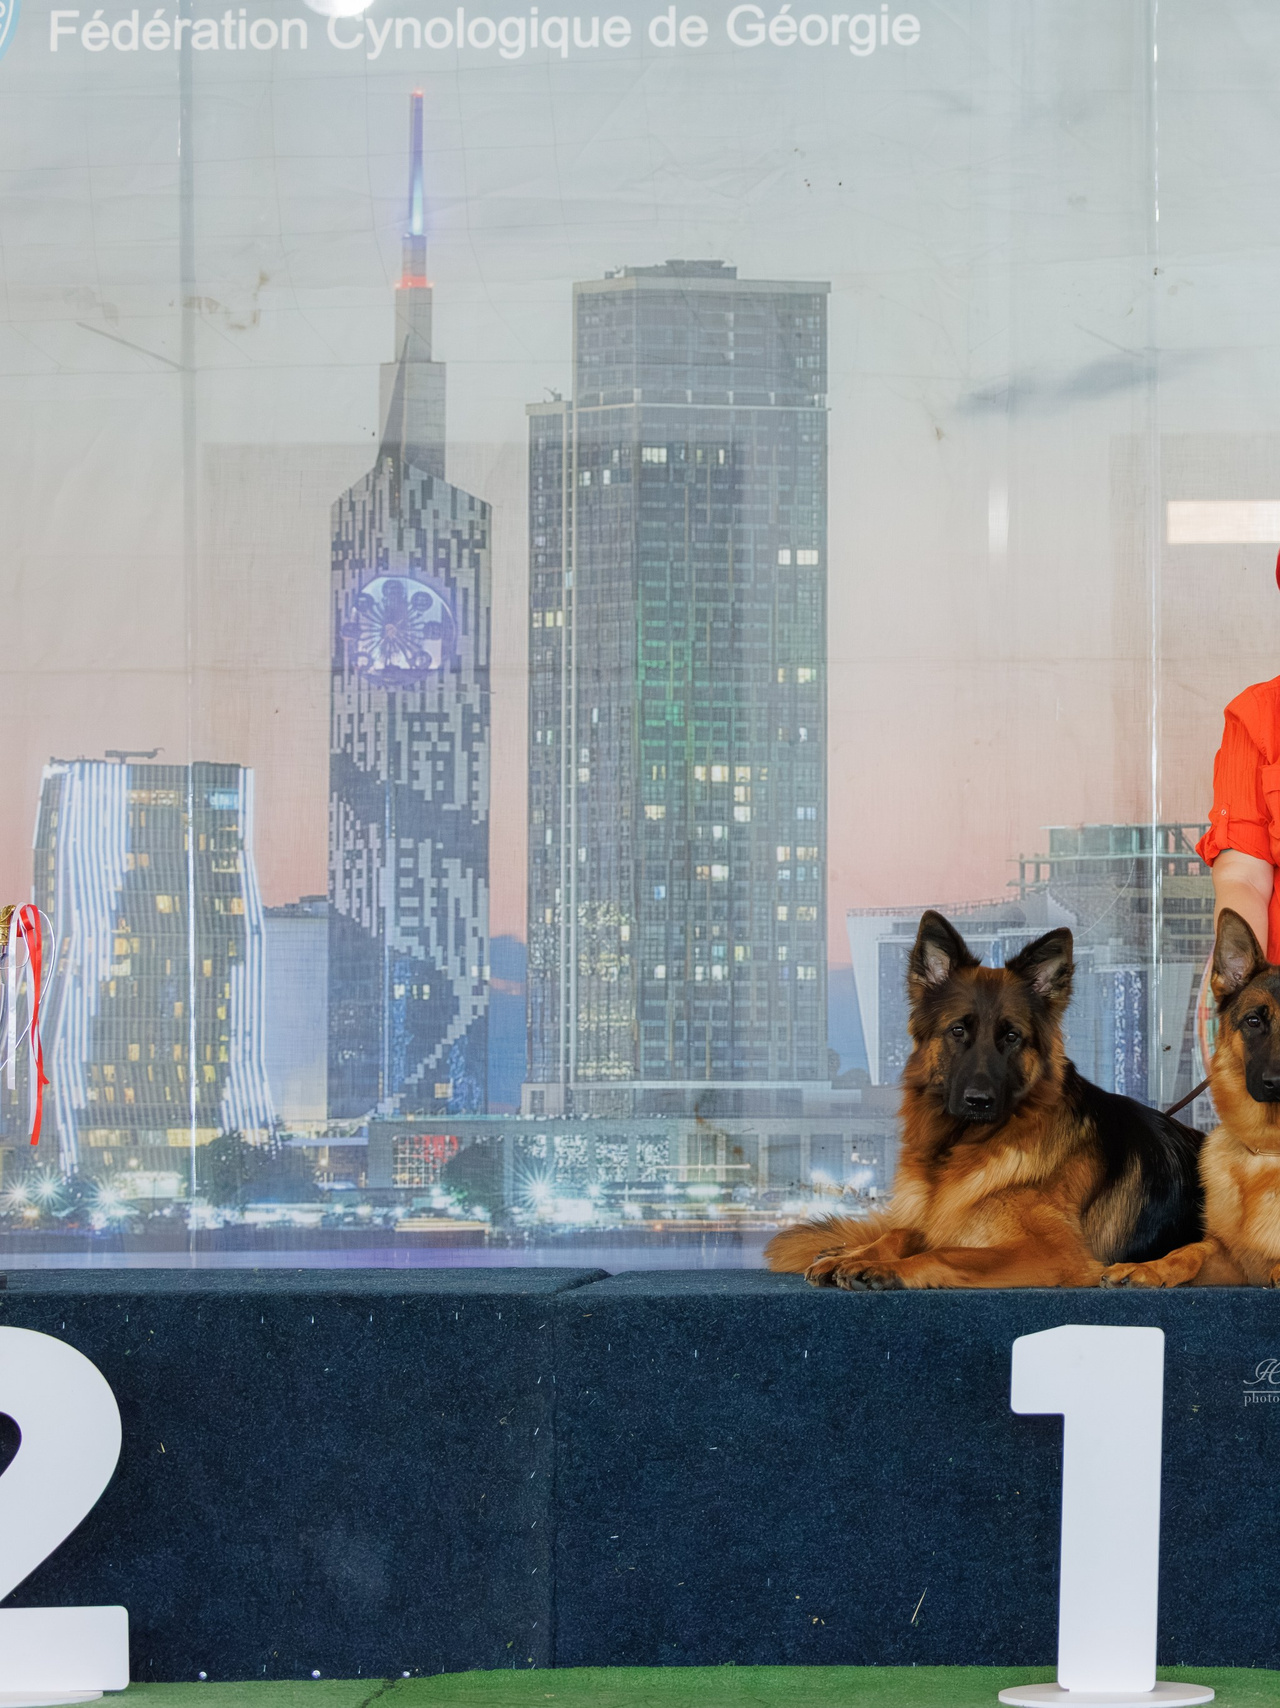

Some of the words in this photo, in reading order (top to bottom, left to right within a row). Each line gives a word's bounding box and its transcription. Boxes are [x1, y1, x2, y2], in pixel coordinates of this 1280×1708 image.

[50, 8, 308, 52] Fédération
[326, 6, 632, 60] Cynologique
[648, 5, 709, 49] de
[726, 3, 921, 56] Géorgie
[1010, 1324, 1165, 1692] 1
